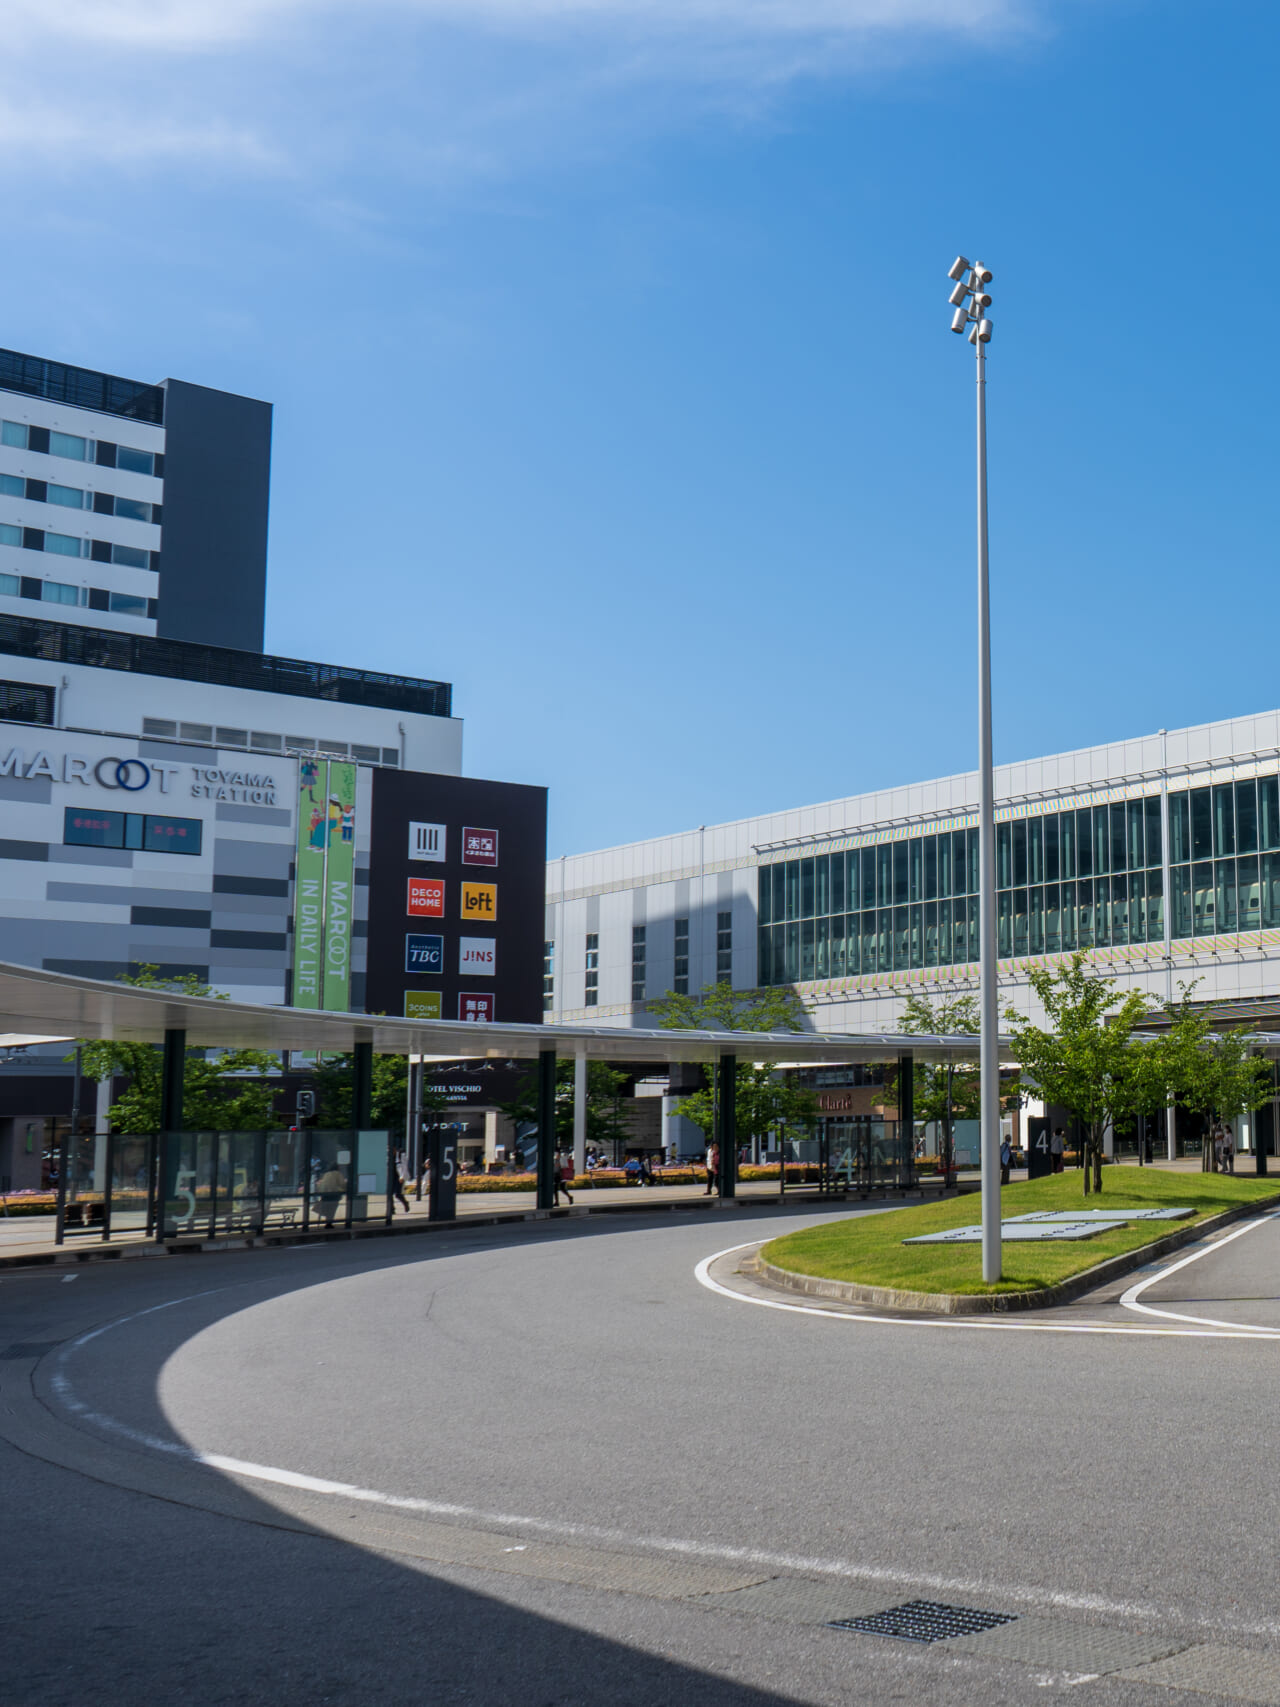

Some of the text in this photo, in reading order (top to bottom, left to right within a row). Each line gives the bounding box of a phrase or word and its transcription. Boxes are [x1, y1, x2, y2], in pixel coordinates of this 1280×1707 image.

[0, 747, 178, 793] MAROOT
[192, 767, 276, 789] TOYAMA
[191, 785, 275, 805] STATION
[411, 888, 441, 897] DECO
[411, 898, 441, 907] HOME
[298, 880, 319, 995] IN DAILY LIFE
[327, 881, 348, 980] MAROOT
[409, 950, 440, 962] TBC
[408, 1004, 438, 1012] 3COINS
[427, 1085, 482, 1093] OTEL VISCHIO
[1035, 1129, 1049, 1154] 4
[442, 1146, 454, 1180] 5
[834, 1147, 856, 1181] 4
[171, 1170, 196, 1222] 5
